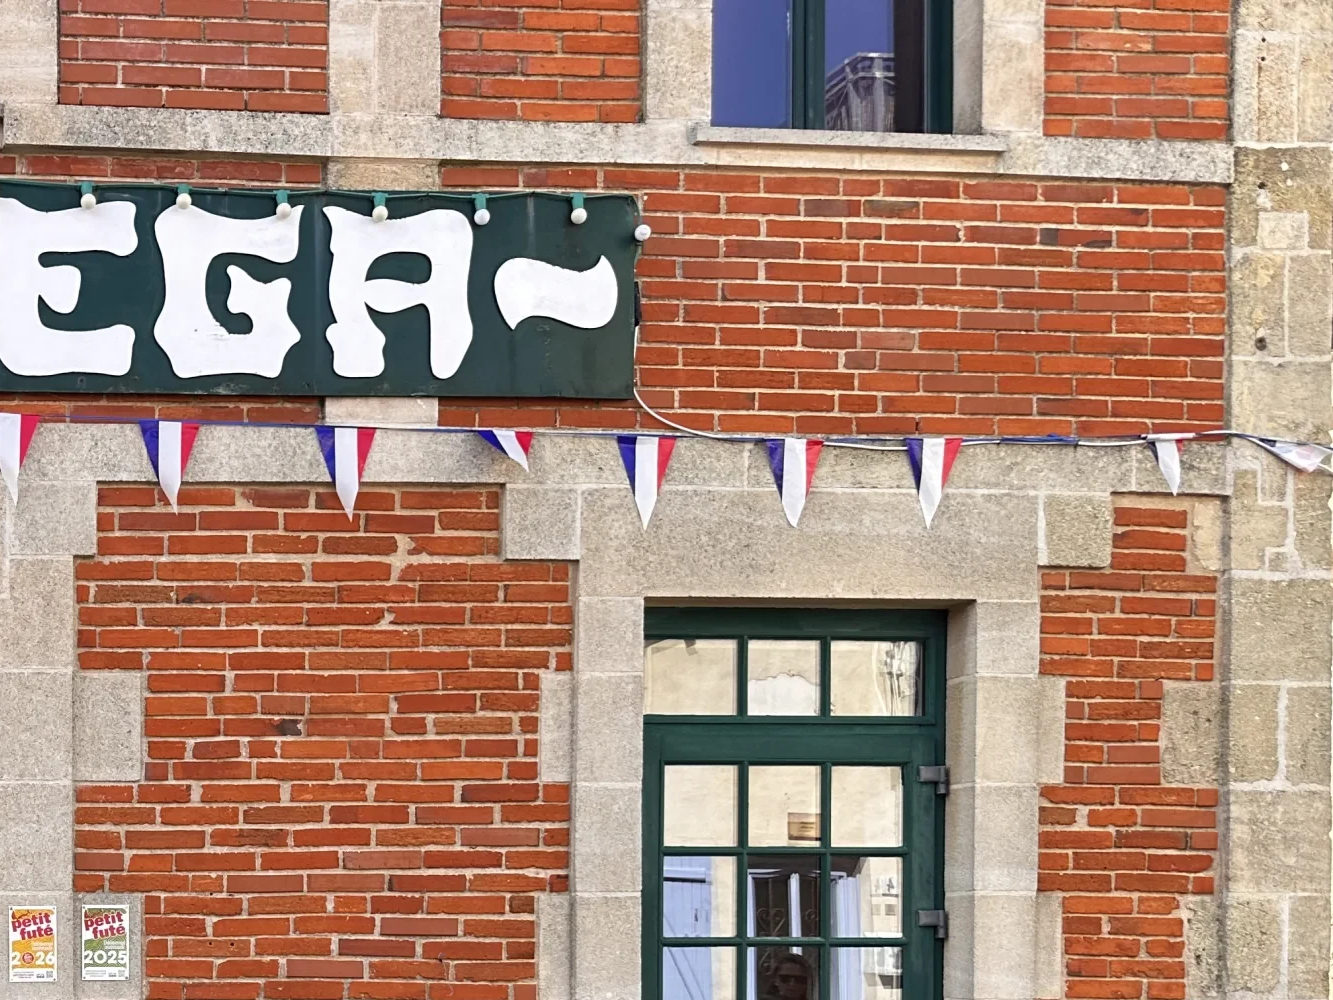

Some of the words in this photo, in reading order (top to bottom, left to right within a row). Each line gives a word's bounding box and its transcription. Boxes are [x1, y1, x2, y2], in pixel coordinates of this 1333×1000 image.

[11, 911, 51, 932] petit
[84, 911, 124, 931] petit
[19, 925, 54, 941] futé
[92, 924, 126, 940] futé
[83, 950, 127, 964] 2025
